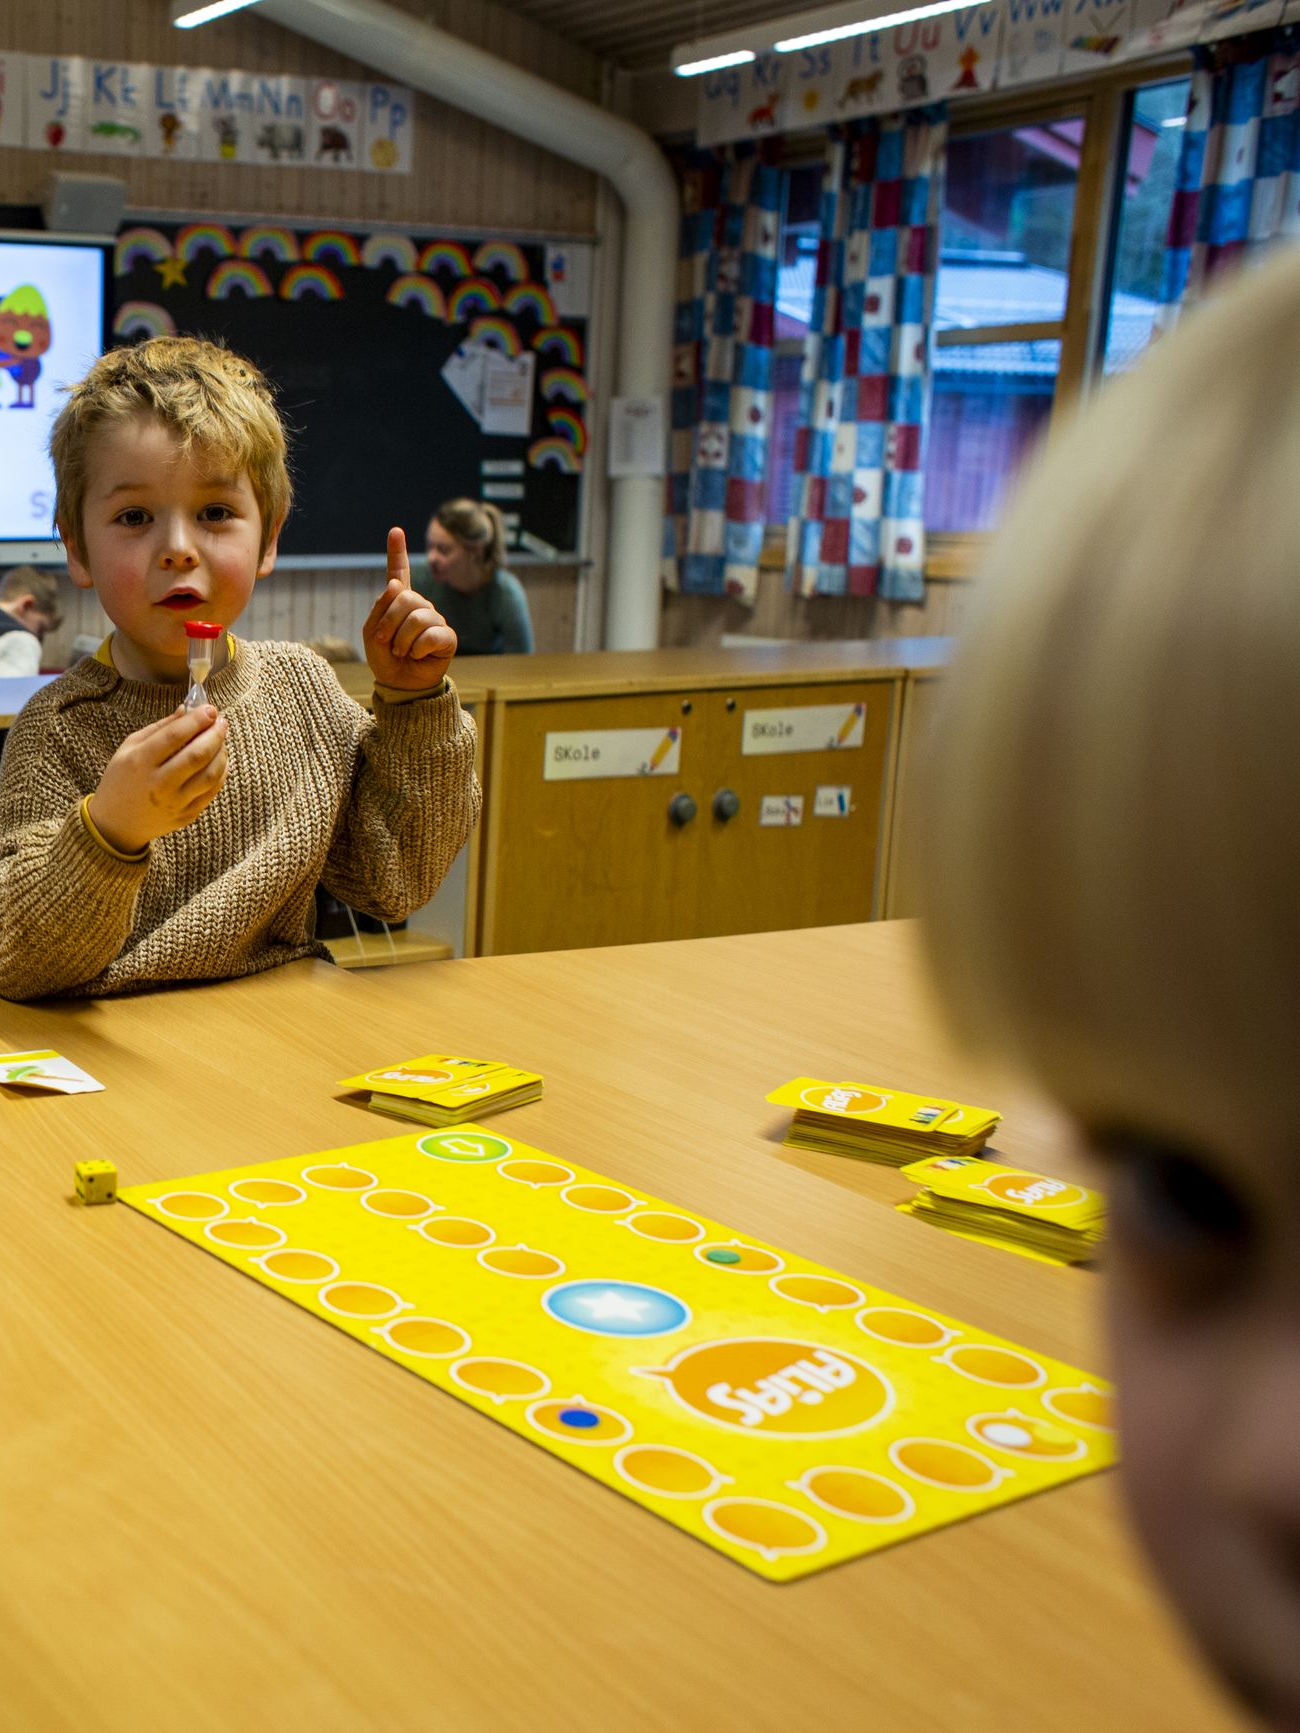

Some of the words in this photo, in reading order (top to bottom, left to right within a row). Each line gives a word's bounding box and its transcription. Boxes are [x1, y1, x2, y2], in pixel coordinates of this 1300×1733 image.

[955, 7, 998, 42] Vv
[39, 60, 70, 117] Jj
[257, 80, 303, 118] Nn
[314, 80, 358, 124] Oo
[370, 86, 407, 140] Pp
